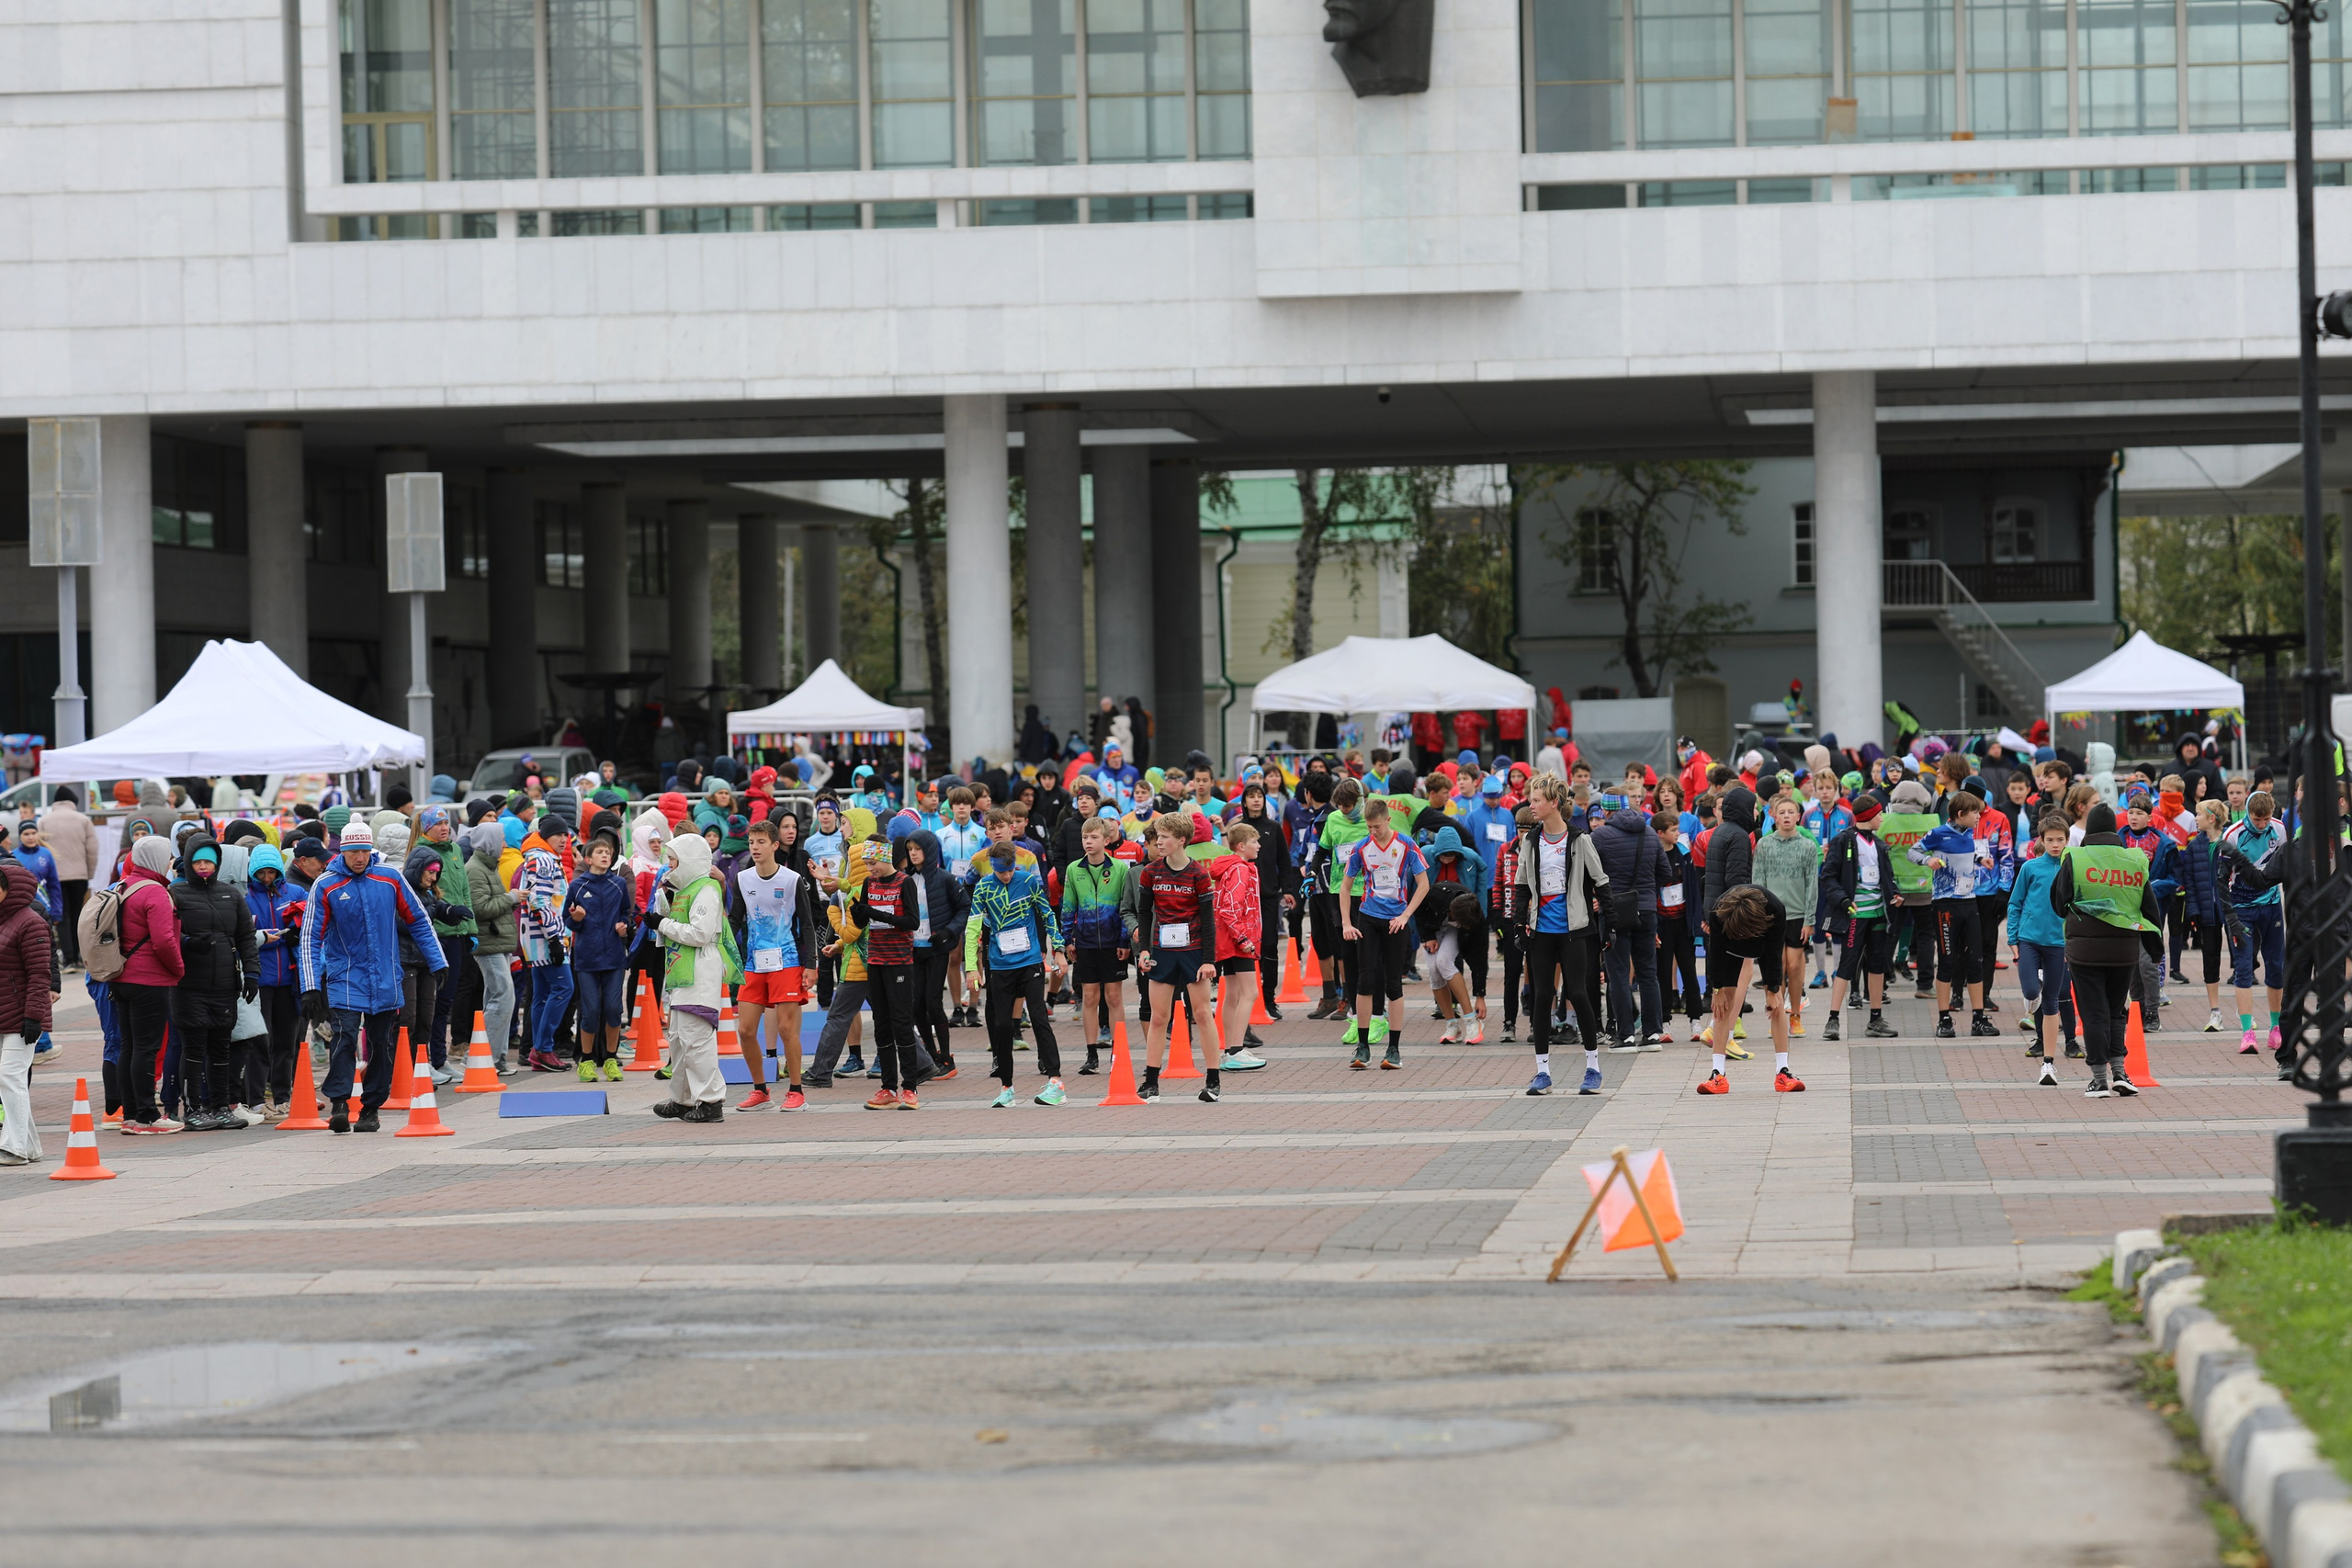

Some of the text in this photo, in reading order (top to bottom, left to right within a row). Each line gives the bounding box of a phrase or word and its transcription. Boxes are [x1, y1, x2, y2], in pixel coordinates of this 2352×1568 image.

[1385, 799, 1412, 818] ДЬЯ
[1503, 853, 1512, 885] WEST
[2086, 866, 2143, 888] СУДЬЯ
[882, 893, 900, 902] WEST
[1504, 887, 1512, 919] NORD
